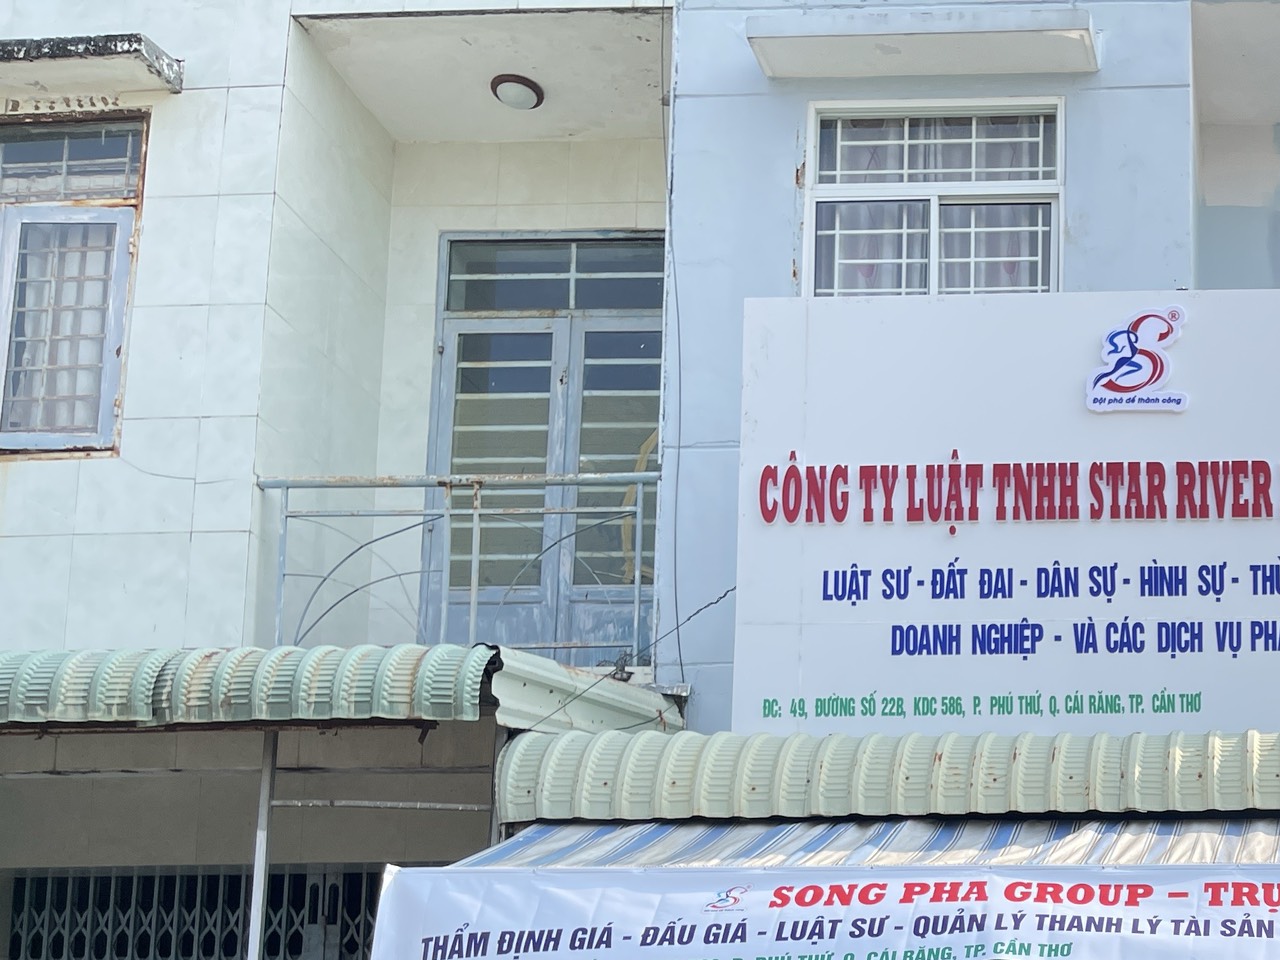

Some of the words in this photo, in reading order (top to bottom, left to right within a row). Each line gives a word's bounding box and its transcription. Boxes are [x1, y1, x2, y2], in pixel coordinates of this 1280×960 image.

[760, 451, 849, 524] CÔNG
[859, 465, 898, 523] TY
[905, 450, 983, 535] LUẬT
[993, 462, 1080, 520] TNHH
[1089, 461, 1168, 519] STAR
[1177, 460, 1273, 518] RIVER
[822, 561, 872, 605] LUẬT
[881, 565, 912, 601] SƯ
[929, 555, 968, 600] ĐẤT
[977, 567, 1014, 600] ĐAI
[1036, 560, 1080, 599] DÂN
[1088, 562, 1119, 604] SỰ
[1139, 556, 1188, 597] HÌNH
[1197, 561, 1229, 603] SỰ
[890, 623, 962, 657] DOANH
[971, 617, 1044, 663] NGHIỆP
[1072, 616, 1099, 655] VÀ
[1105, 615, 1146, 654] CÁC
[1157, 621, 1204, 661] DỊCH
[1214, 620, 1242, 659] VỤ
[762, 698, 782, 718] ĐC:
[790, 698, 808, 718] 49,
[814, 694, 856, 717] ĐƯỜNG
[860, 690, 877, 716] SỐ
[881, 698, 907, 718] 22B,
[913, 697, 938, 716] KDC
[940, 696, 966, 717] 586,
[973, 697, 982, 715] P.
[990, 691, 1014, 715] PHÚ
[1017, 690, 1044, 716] THỨ,
[1049, 697, 1060, 714] Q.
[1065, 689, 1085, 714] CÁI
[1088, 690, 1126, 715] RĂNG,
[1129, 695, 1145, 713] TP.
[1151, 687, 1177, 713] CẦN
[1179, 692, 1203, 712] THƠ
[768, 882, 889, 909] SONG
[899, 880, 989, 905] PHA
[1003, 881, 1155, 908] GROUP
[496, 927, 564, 960] ĐỊNH
[568, 921, 614, 951] GIÁ
[639, 917, 698, 947] ĐẤU
[703, 917, 749, 945] GIÁ
[774, 915, 844, 946] LUẬT
[848, 914, 891, 940] SƯ
[912, 907, 988, 940] QUẢN
[994, 909, 1028, 932] LÝ
[1035, 913, 1123, 934] THANH
[1130, 914, 1163, 935] LÝ
[1169, 914, 1212, 938] TÀI
[1219, 911, 1276, 940] SẢN
[963, 942, 987, 959] TP.
[991, 936, 1032, 957] CẦN
[1037, 940, 1073, 958] THƠ
